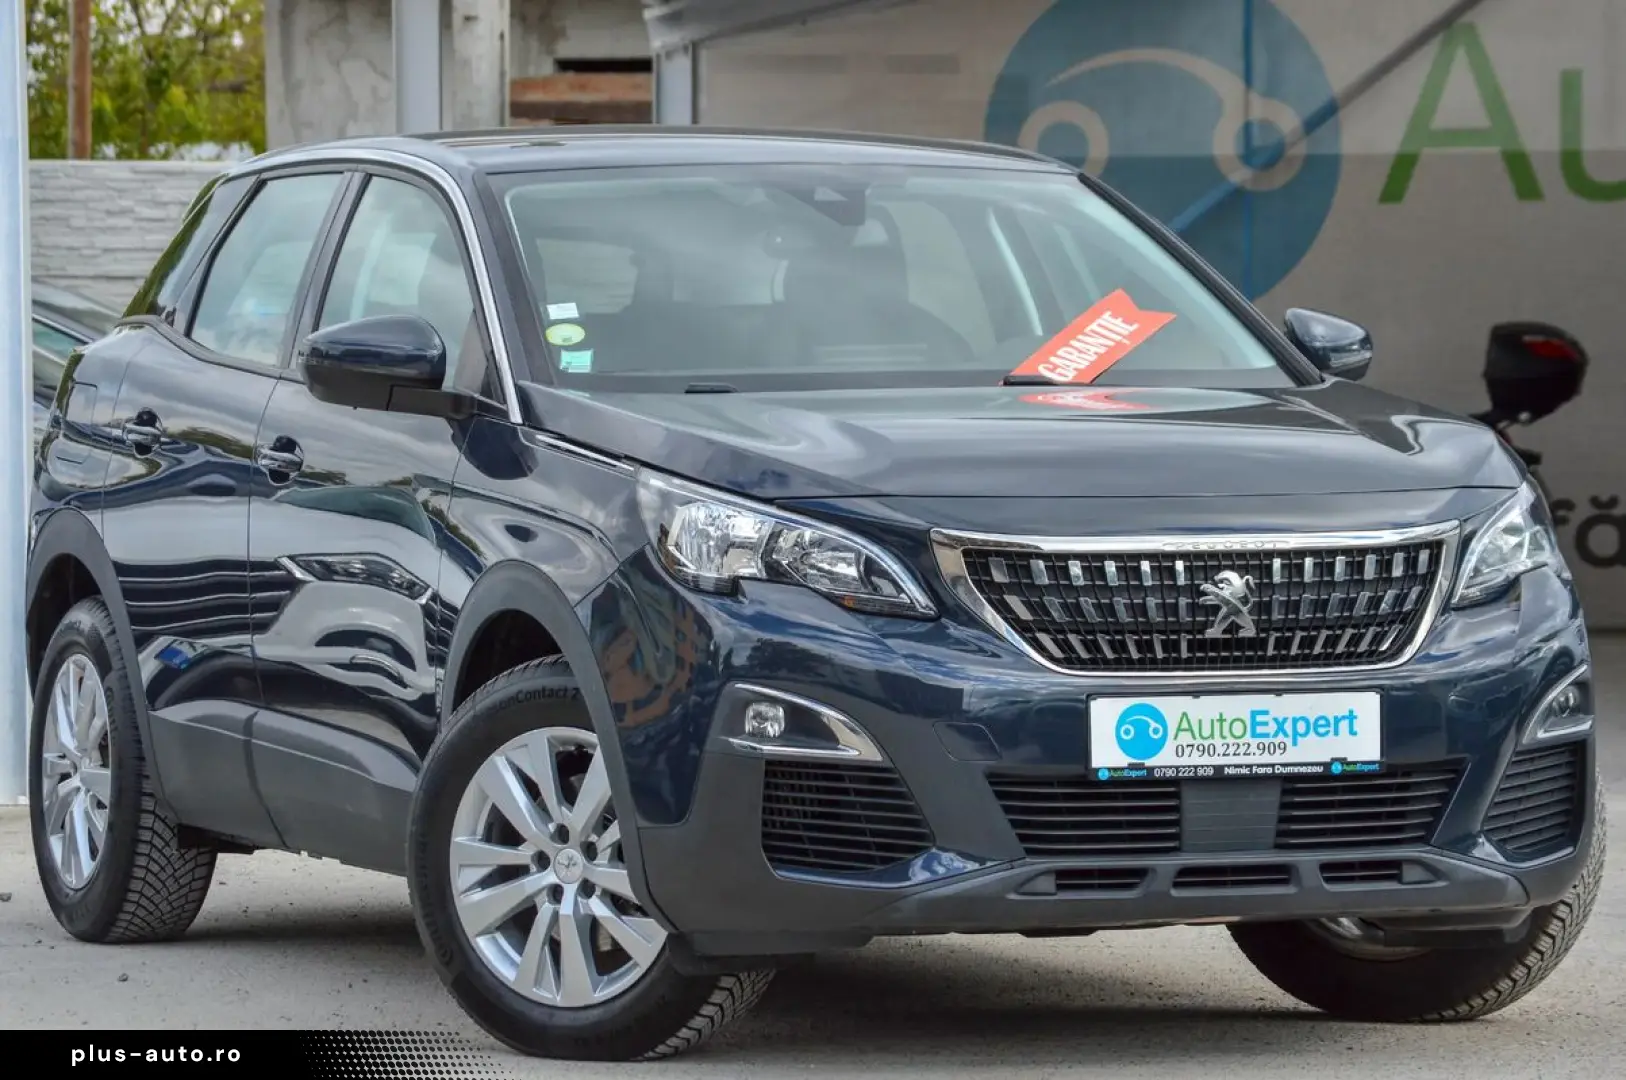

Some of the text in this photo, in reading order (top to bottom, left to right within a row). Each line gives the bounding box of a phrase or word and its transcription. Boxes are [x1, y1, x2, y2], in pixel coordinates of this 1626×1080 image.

[1173, 708, 1358, 747] AutoExpert
[1175, 741, 1288, 758] 0790.222.909
[1153, 767, 1177, 777] 0790
[1178, 767, 1195, 776] 222
[1197, 766, 1214, 776] 909
[1224, 766, 1251, 775] Nimic
[1252, 765, 1273, 774] Fara
[1274, 764, 1324, 774] Dumnezeu
